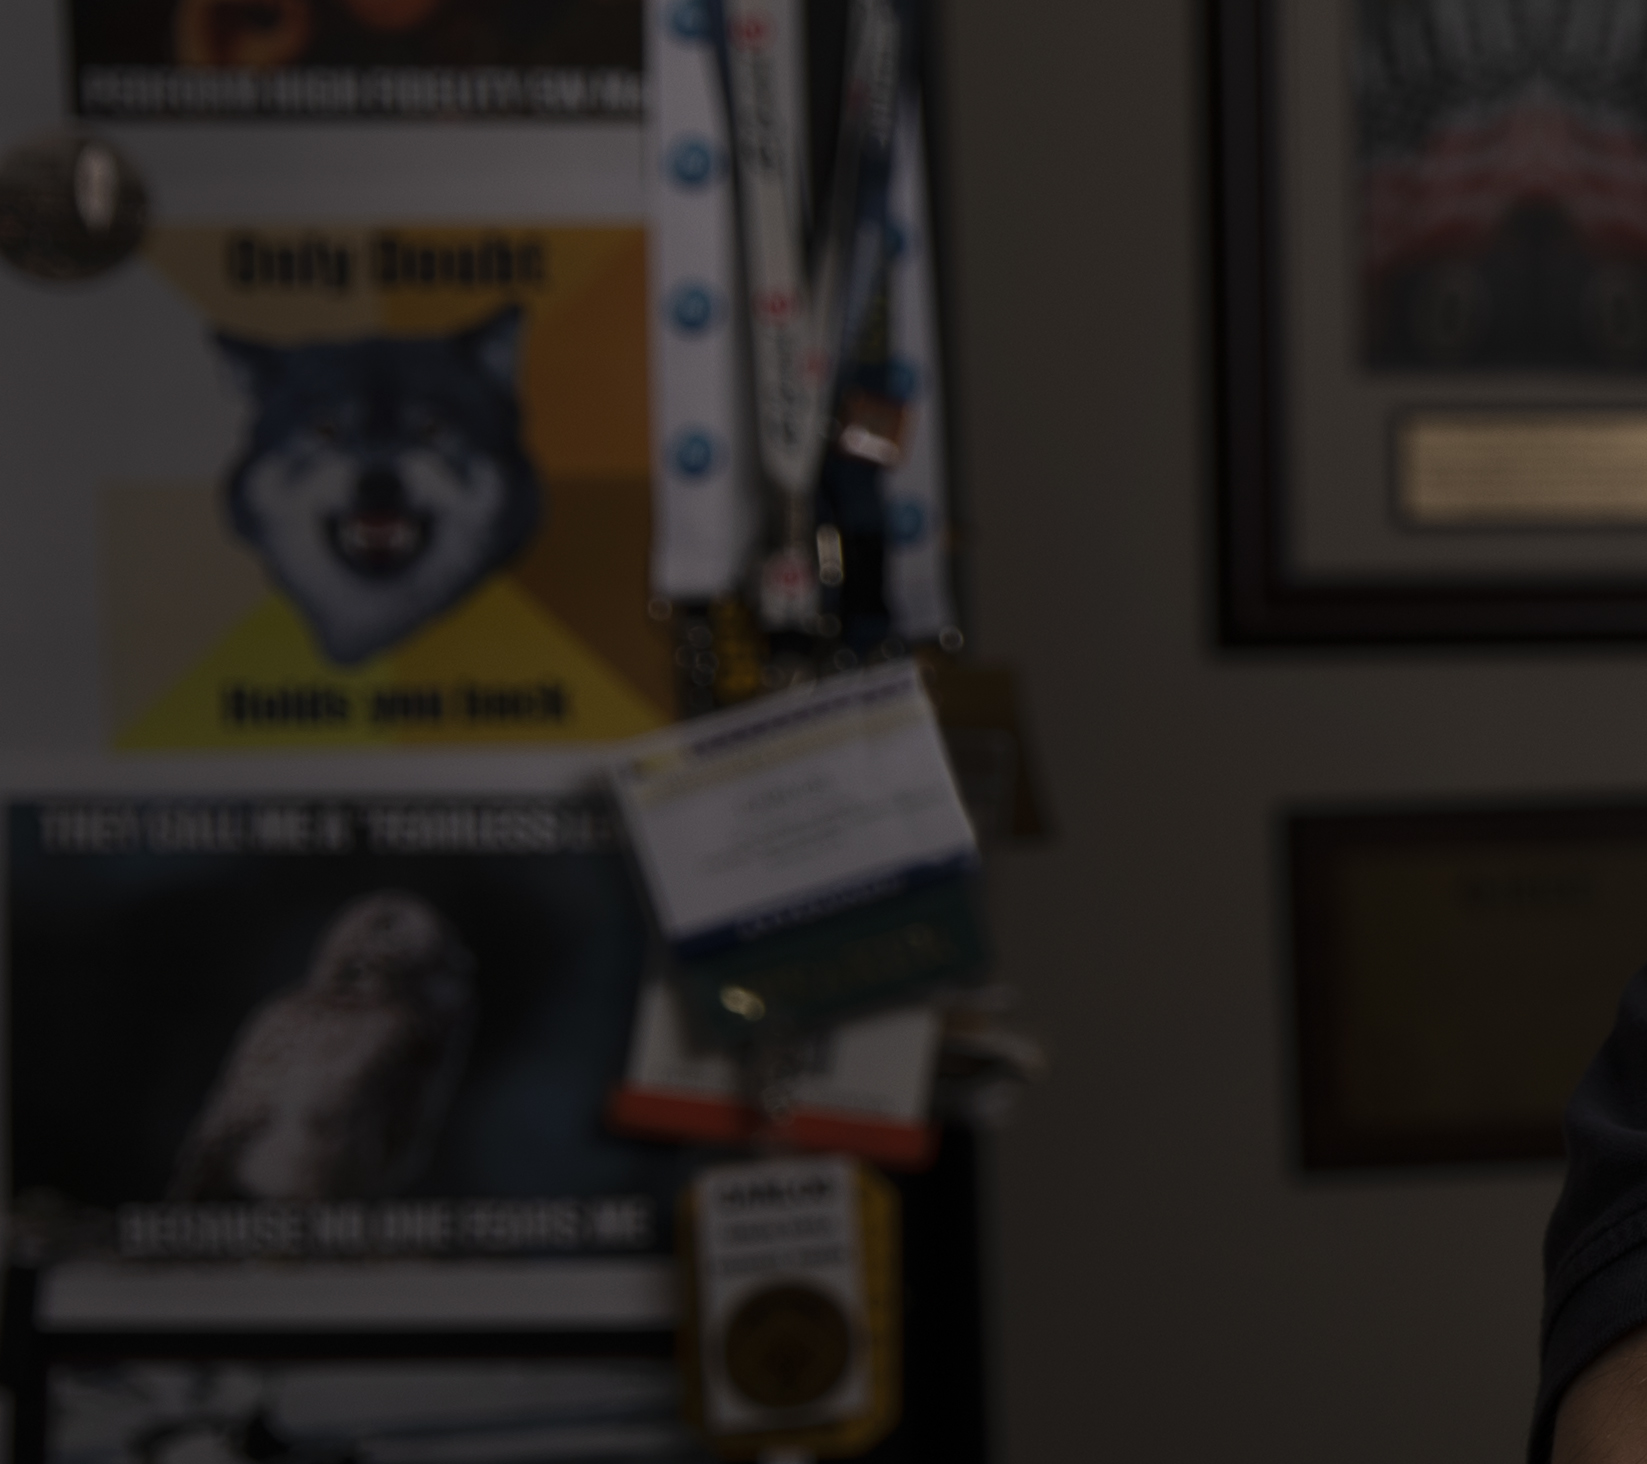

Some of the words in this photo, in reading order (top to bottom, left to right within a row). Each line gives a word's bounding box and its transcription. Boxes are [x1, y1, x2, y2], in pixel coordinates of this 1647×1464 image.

[229, 231, 354, 294] Only
[368, 230, 550, 292] Doubt
[222, 680, 356, 727] Holds
[364, 687, 450, 730] you
[457, 679, 572, 724] back
[41, 805, 144, 850] THEY
[149, 805, 248, 850] CALL
[120, 1203, 306, 1250] BECAUSE
[312, 1201, 373, 1248] NO
[376, 1200, 456, 1247] ONE
[588, 1196, 650, 1244] ME
